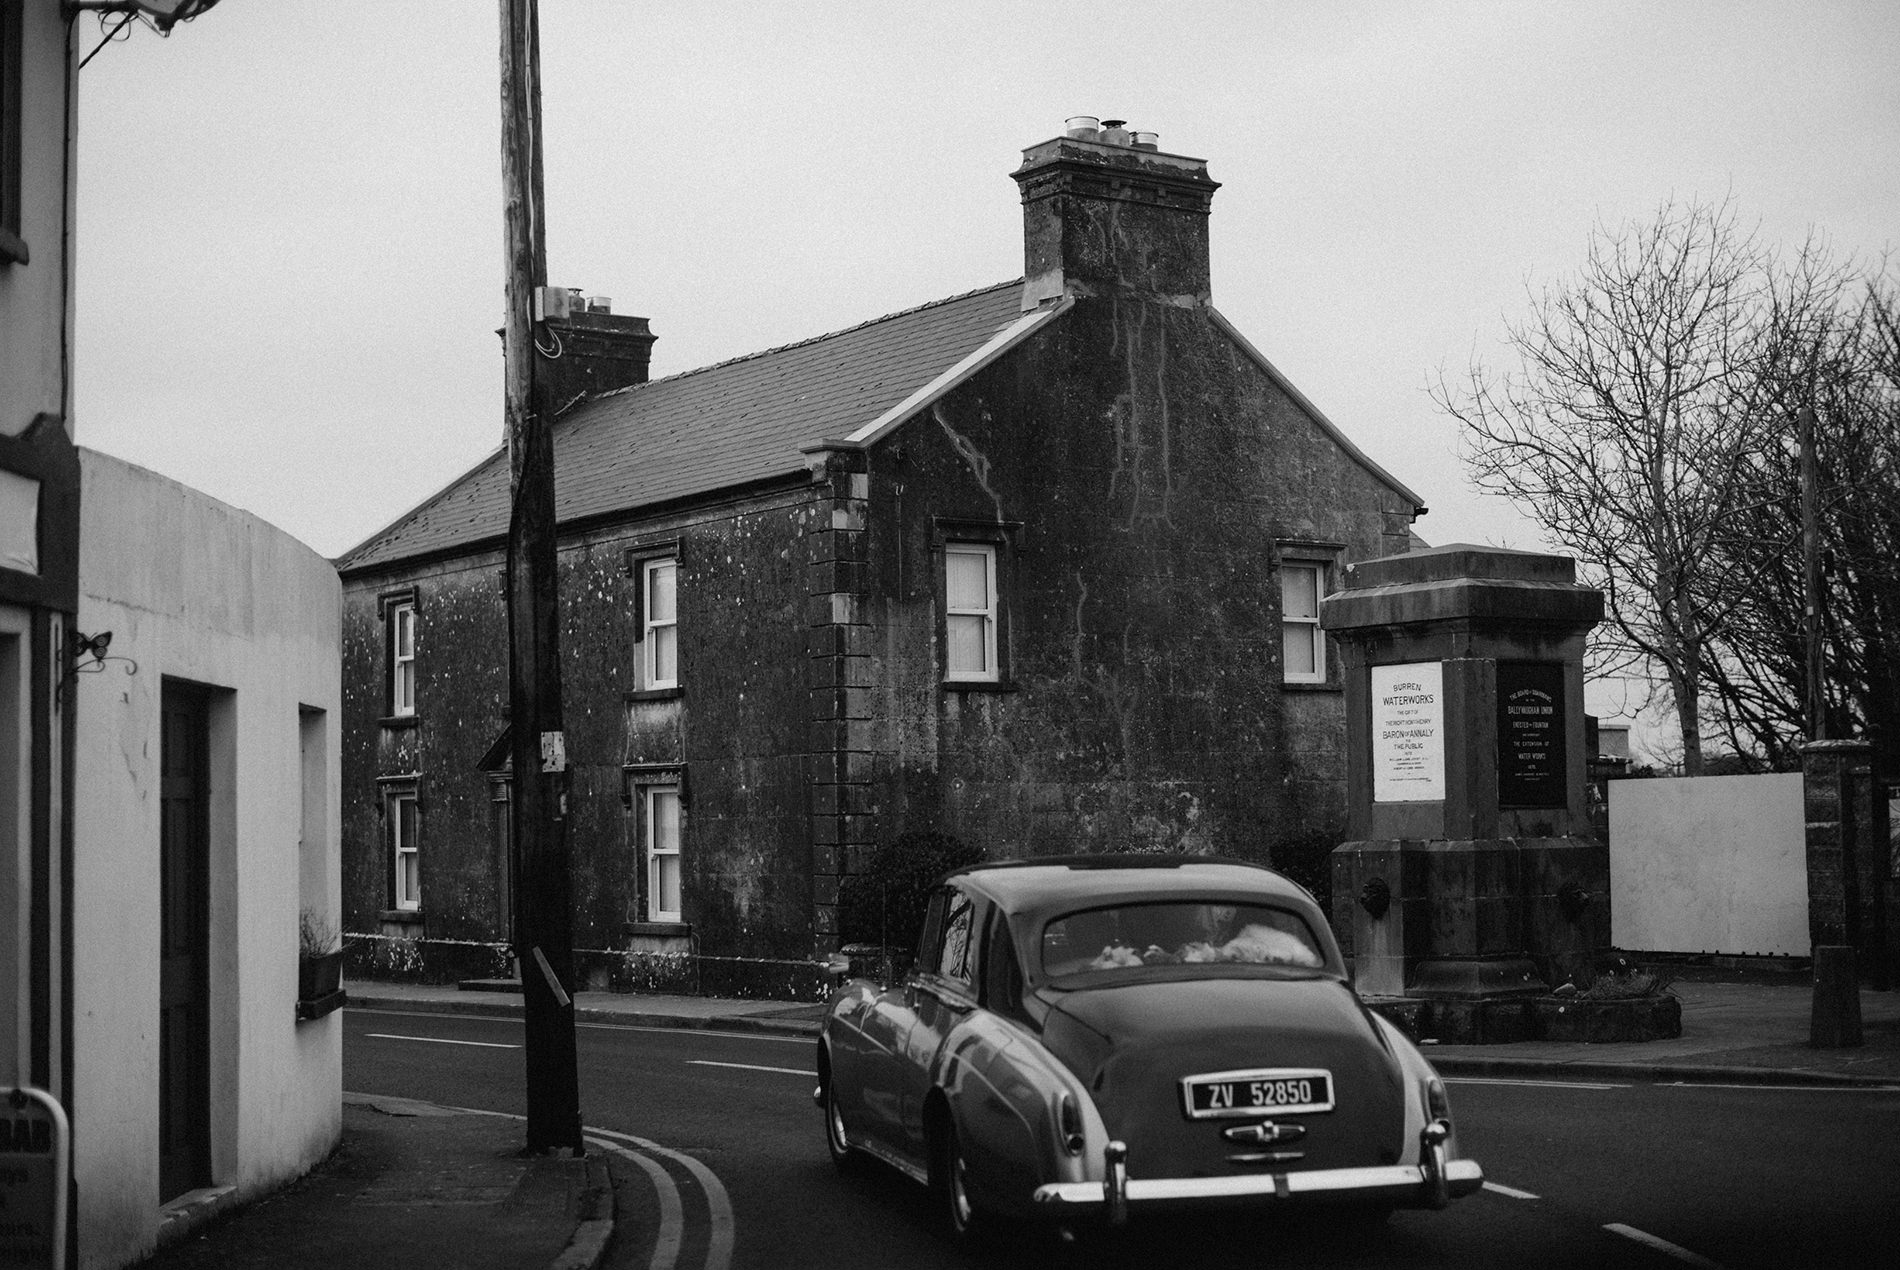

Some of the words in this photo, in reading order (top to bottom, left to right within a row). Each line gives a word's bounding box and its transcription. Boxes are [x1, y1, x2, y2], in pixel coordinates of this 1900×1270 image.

[1393, 682, 1422, 692] BURREN
[1383, 694, 1434, 705] WATERWORKS
[1383, 731, 1404, 739] BARON
[1410, 729, 1433, 738] ANNALY
[1208, 1084, 1234, 1108] ZV
[1250, 1080, 1312, 1106] 52850
